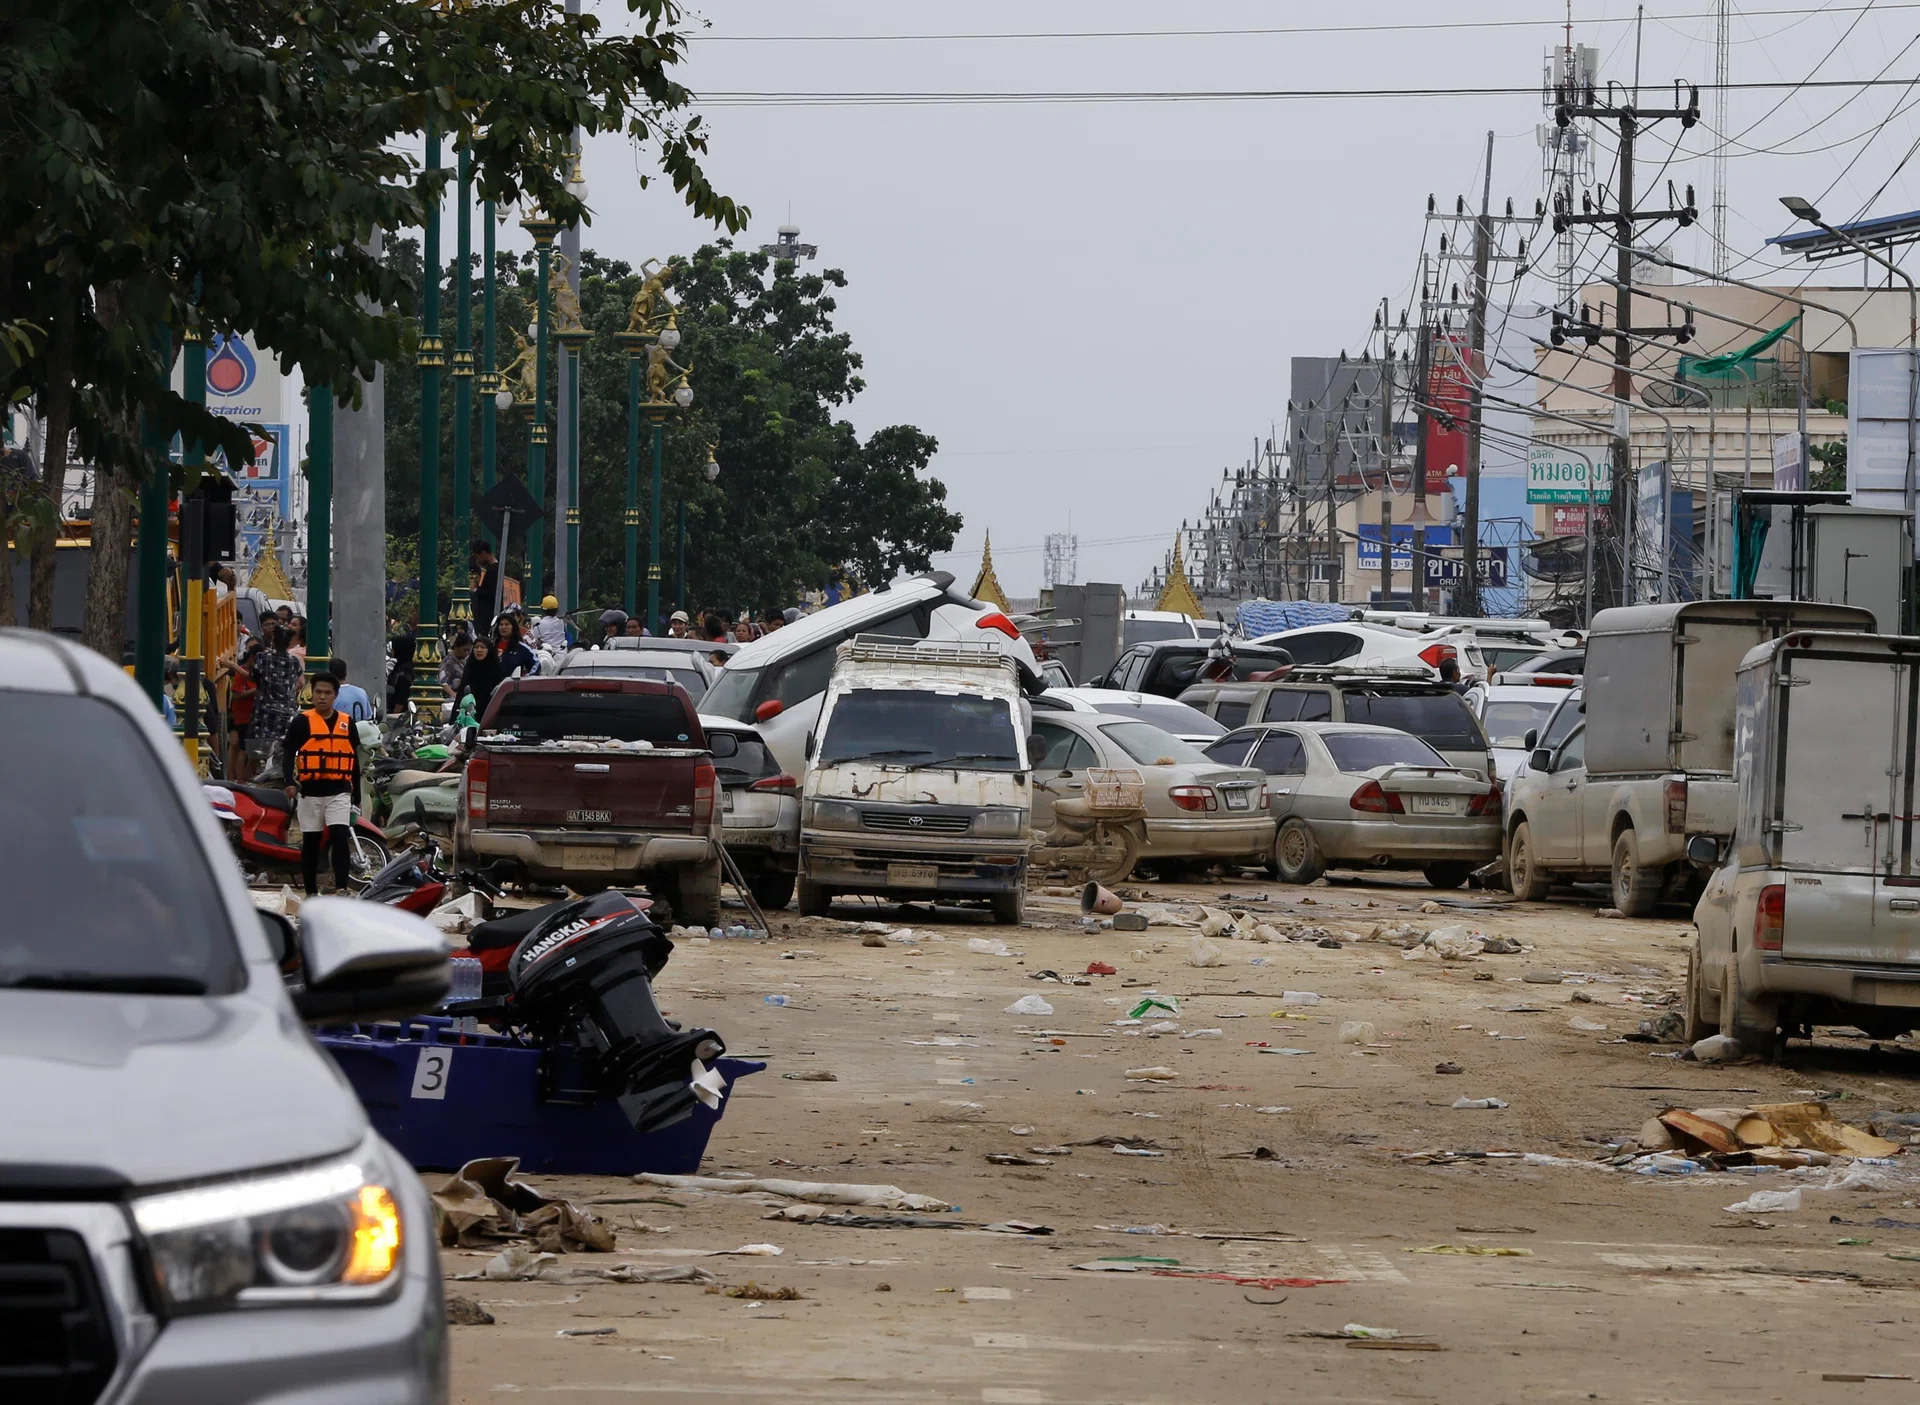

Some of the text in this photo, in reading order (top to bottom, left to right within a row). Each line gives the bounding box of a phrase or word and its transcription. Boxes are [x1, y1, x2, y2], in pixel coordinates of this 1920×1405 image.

[1431, 797, 1450, 807] 3425
[595, 811, 610, 821] BKK
[1793, 878, 1823, 886] TOYOTA
[522, 918, 591, 962] HANGKAI
[421, 1056, 444, 1091] 3
